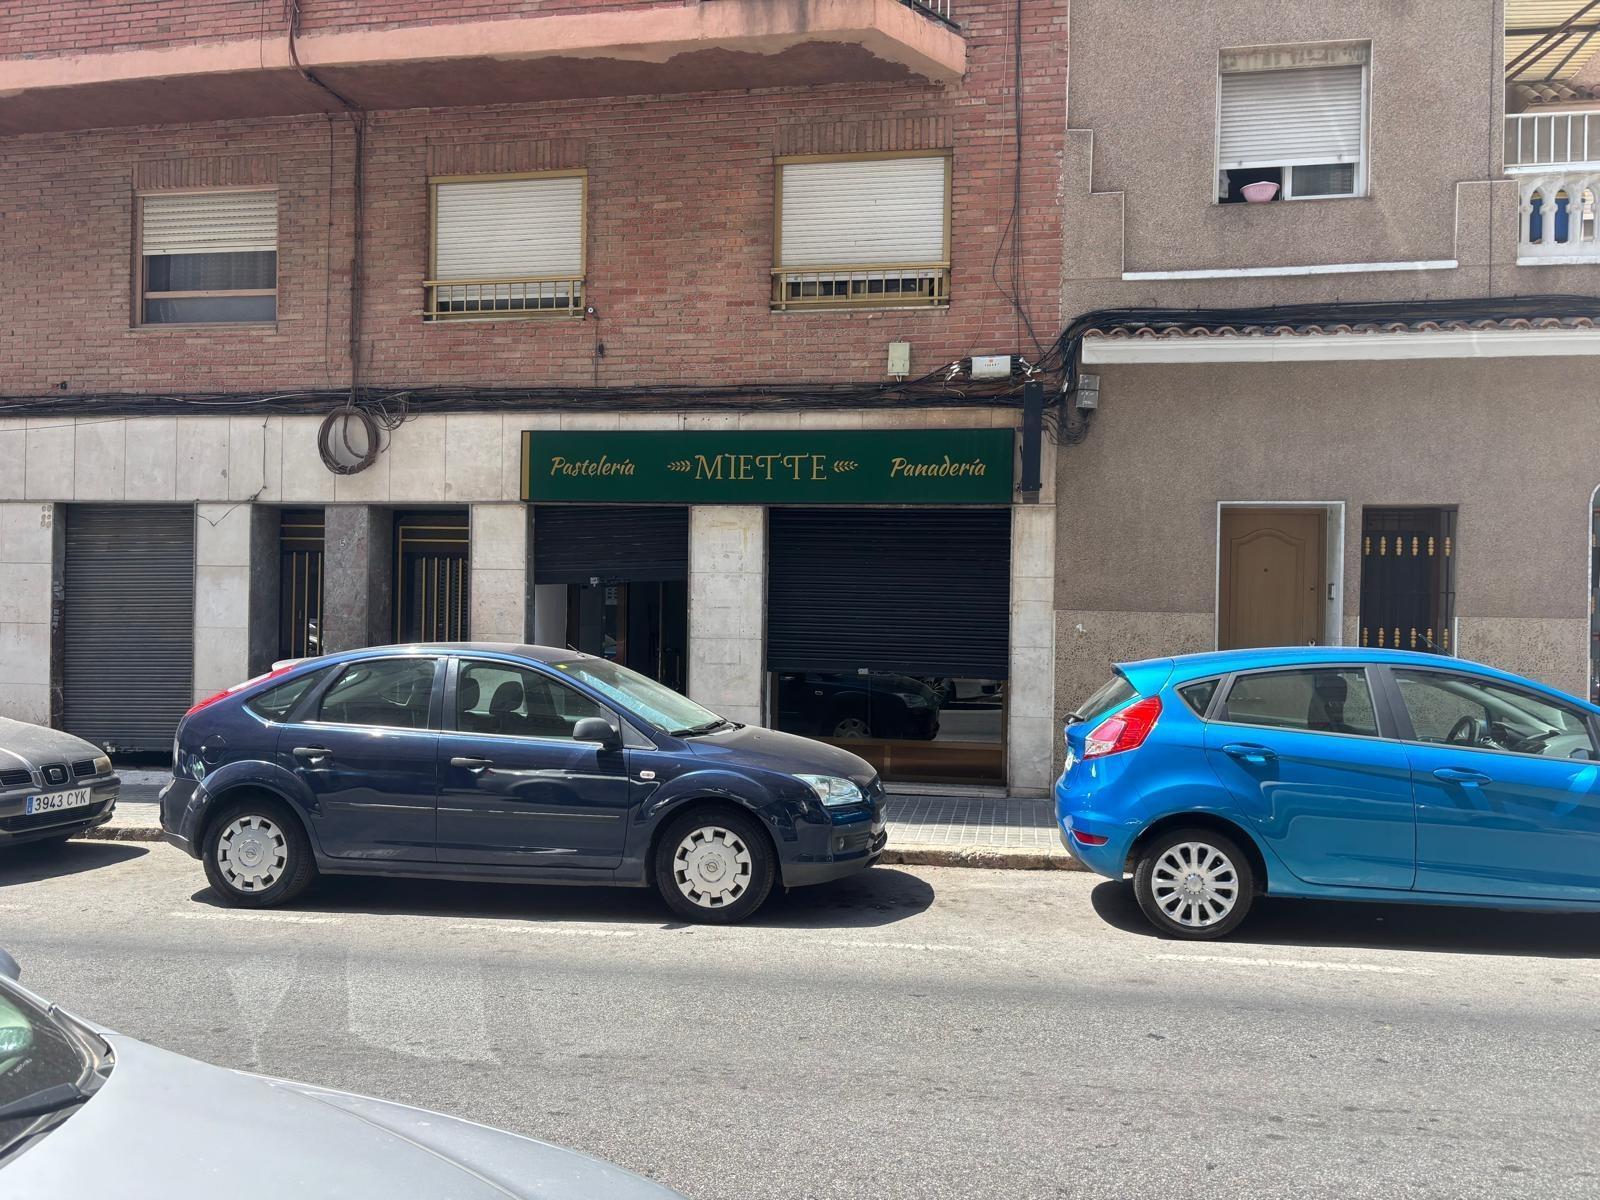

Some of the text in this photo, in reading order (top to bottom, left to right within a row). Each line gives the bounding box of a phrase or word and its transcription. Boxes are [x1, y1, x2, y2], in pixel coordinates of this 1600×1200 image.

[550, 452, 986, 480] Pastelería MIETTE Panadería
[35, 790, 87, 811] 3943 CYK
